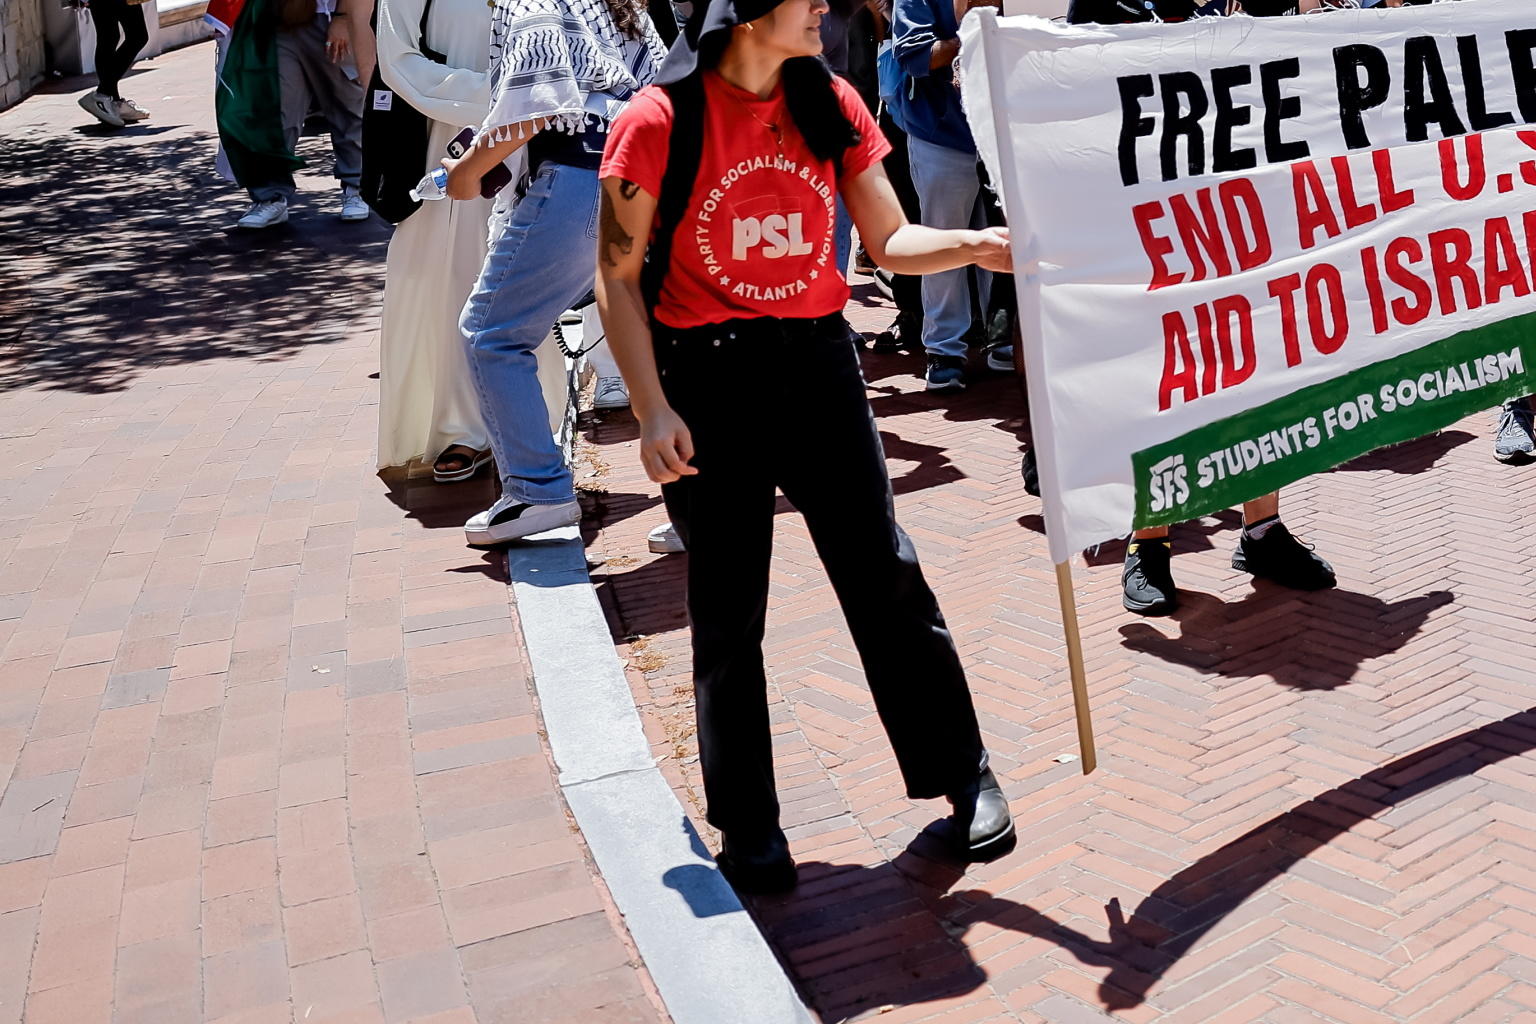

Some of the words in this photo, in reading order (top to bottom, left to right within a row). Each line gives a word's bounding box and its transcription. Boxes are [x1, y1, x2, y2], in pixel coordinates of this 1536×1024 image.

[1117, 55, 1311, 187] FREE
[698, 188, 725, 223] FOR
[798, 166, 810, 181] &
[696, 225, 723, 275] PARTY
[731, 212, 813, 261] PSL
[808, 174, 835, 267] LIBERATION
[1132, 176, 1273, 293] END
[1290, 148, 1415, 250] ALL
[731, 279, 808, 301] ATLANTA
[1158, 293, 1257, 412] AID
[1267, 262, 1349, 368] TO
[1148, 454, 1190, 513] SFS
[1196, 417, 1322, 489] STUDENTS
[1323, 392, 1378, 441] FOR
[1379, 346, 1526, 413] SOCIALISM
